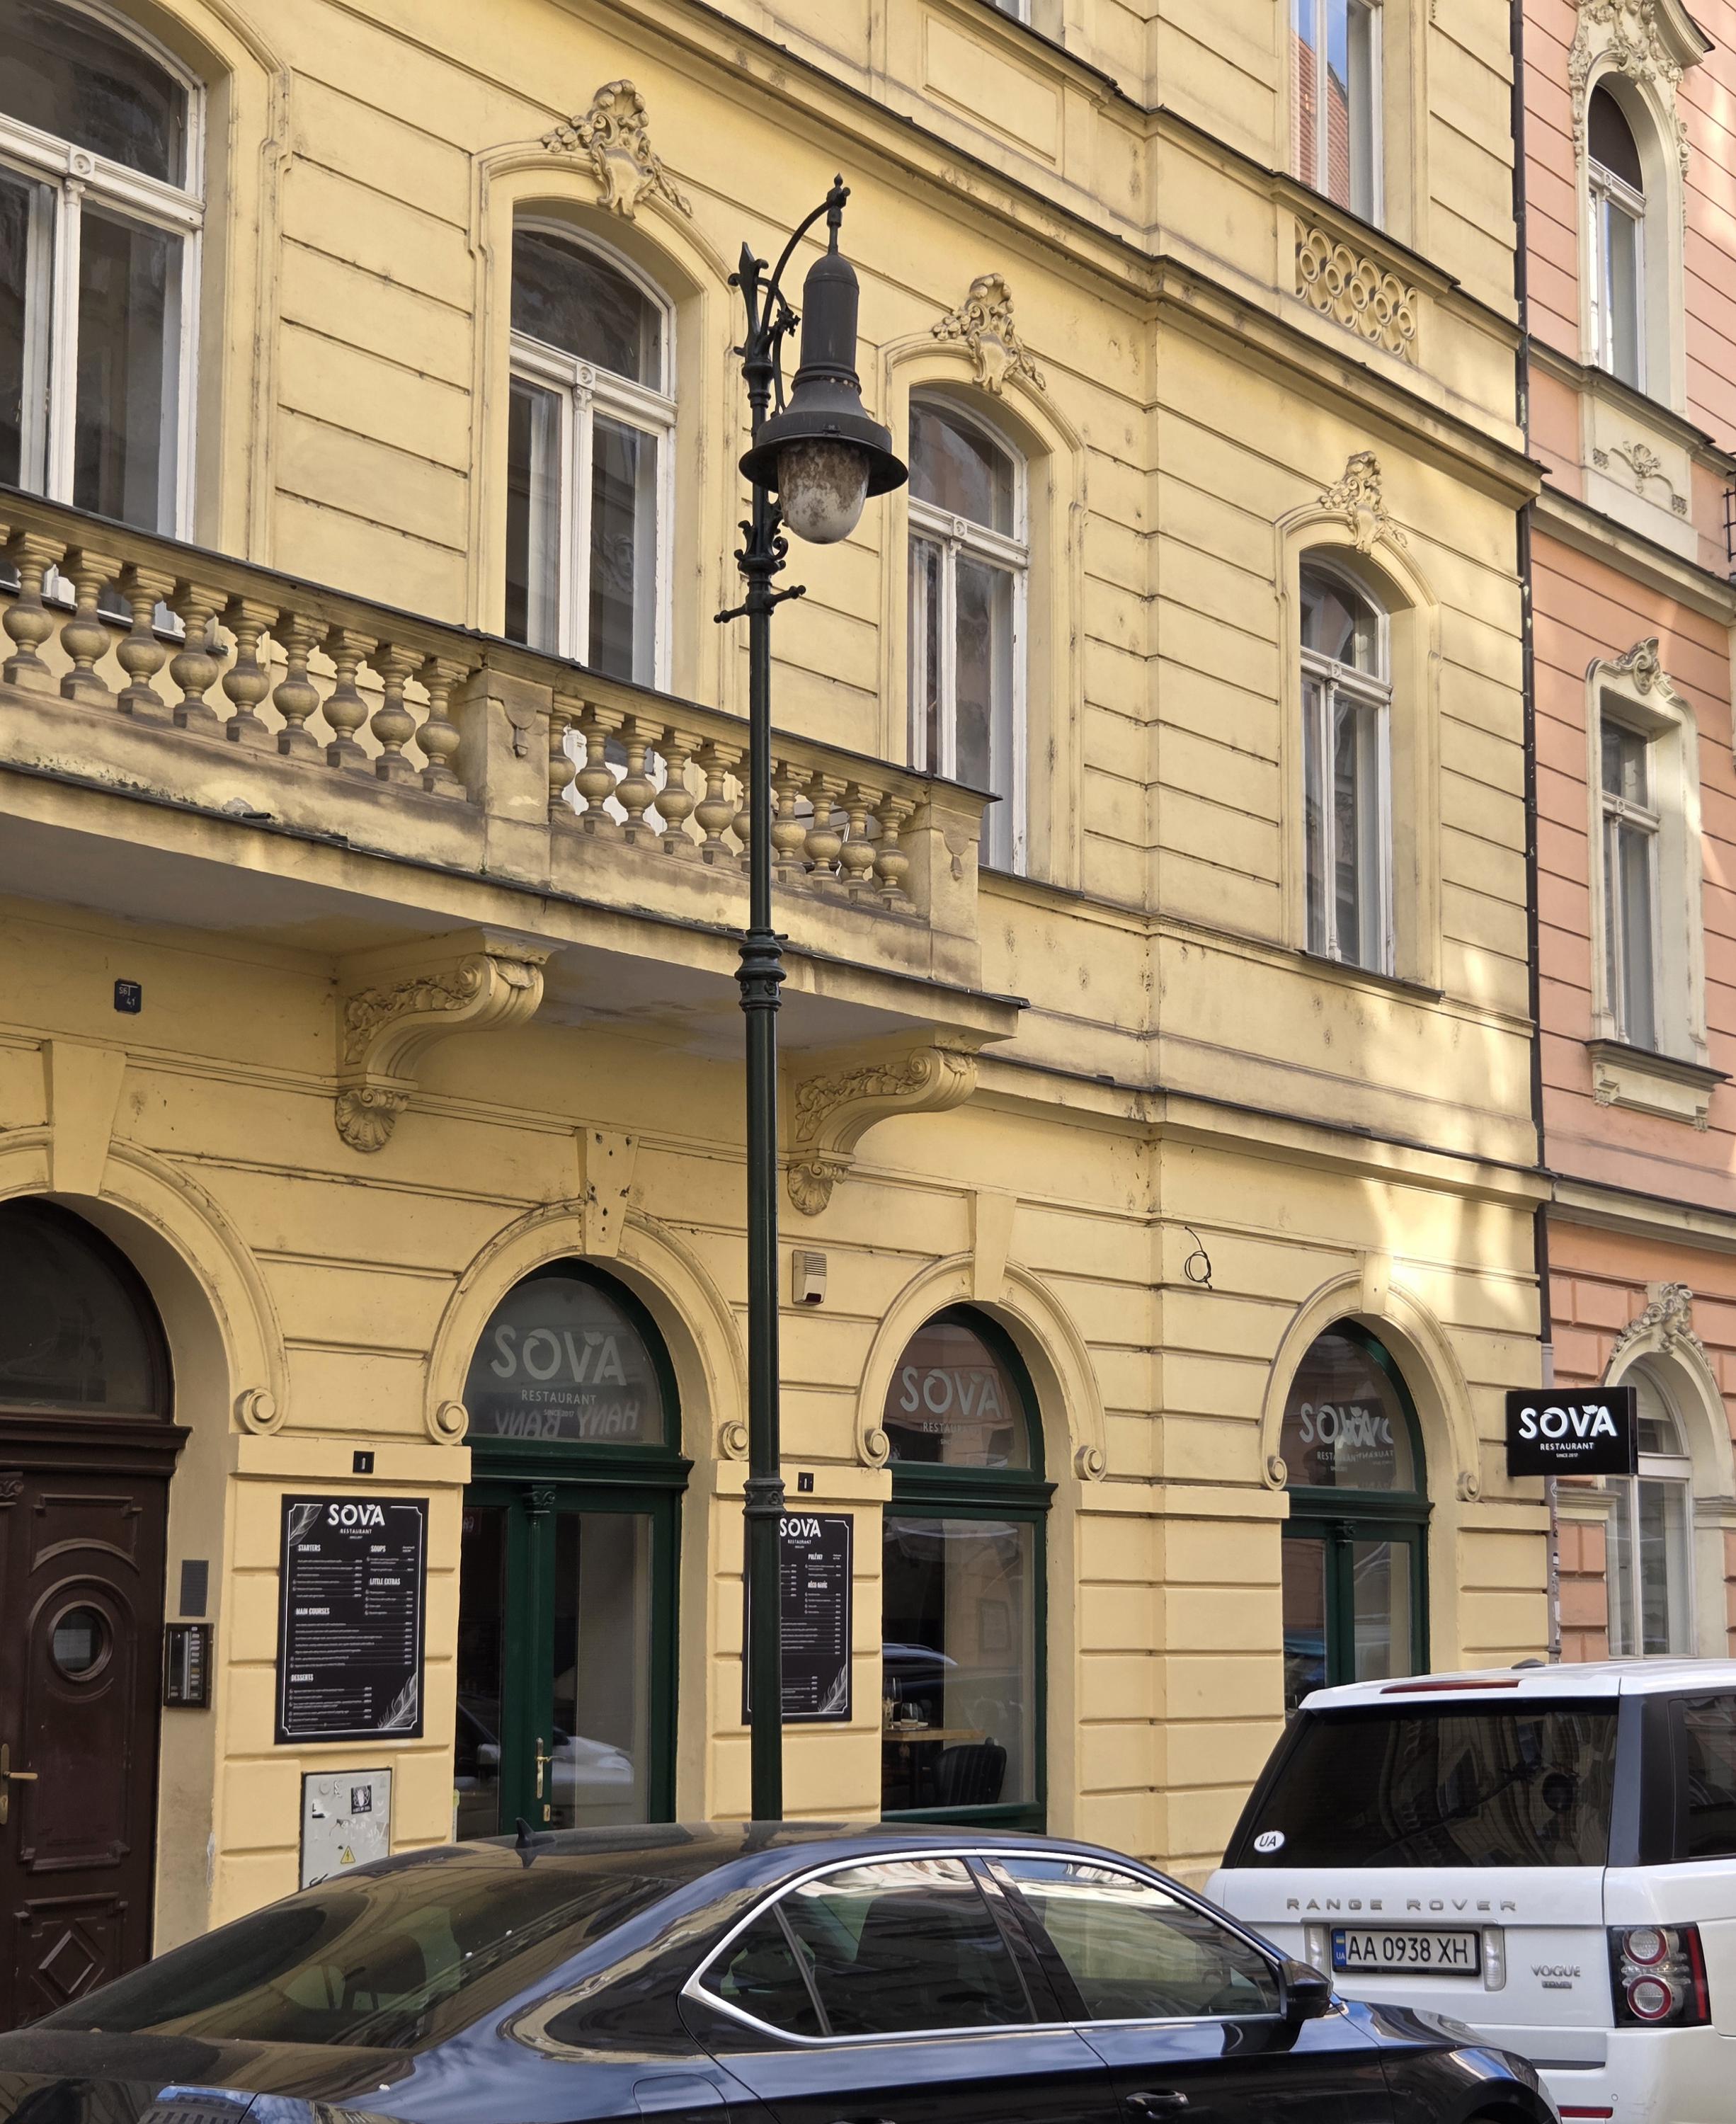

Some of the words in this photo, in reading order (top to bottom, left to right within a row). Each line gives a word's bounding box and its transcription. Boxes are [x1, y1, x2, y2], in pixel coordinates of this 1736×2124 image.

[491, 1325, 627, 1386] SOVA
[522, 1389, 596, 1405] RESTAURANT
[900, 1366, 1002, 1418] SOVA
[1518, 1405, 1618, 1439] SOVA
[1540, 1442, 1594, 1451] RESTAURANT
[328, 1504, 386, 1526] SOVA
[780, 1518, 821, 1538] SOVA
[1259, 1835, 1277, 1846] UA
[1286, 1897, 1384, 1911] RANGE
[1406, 1898, 1517, 1912] ROVER
[1348, 1936, 1377, 1960] AA
[1383, 1936, 1432, 1962] 0938
[1437, 1938, 1468, 1964] XH
[1531, 1965, 1581, 1977] VOGUE
